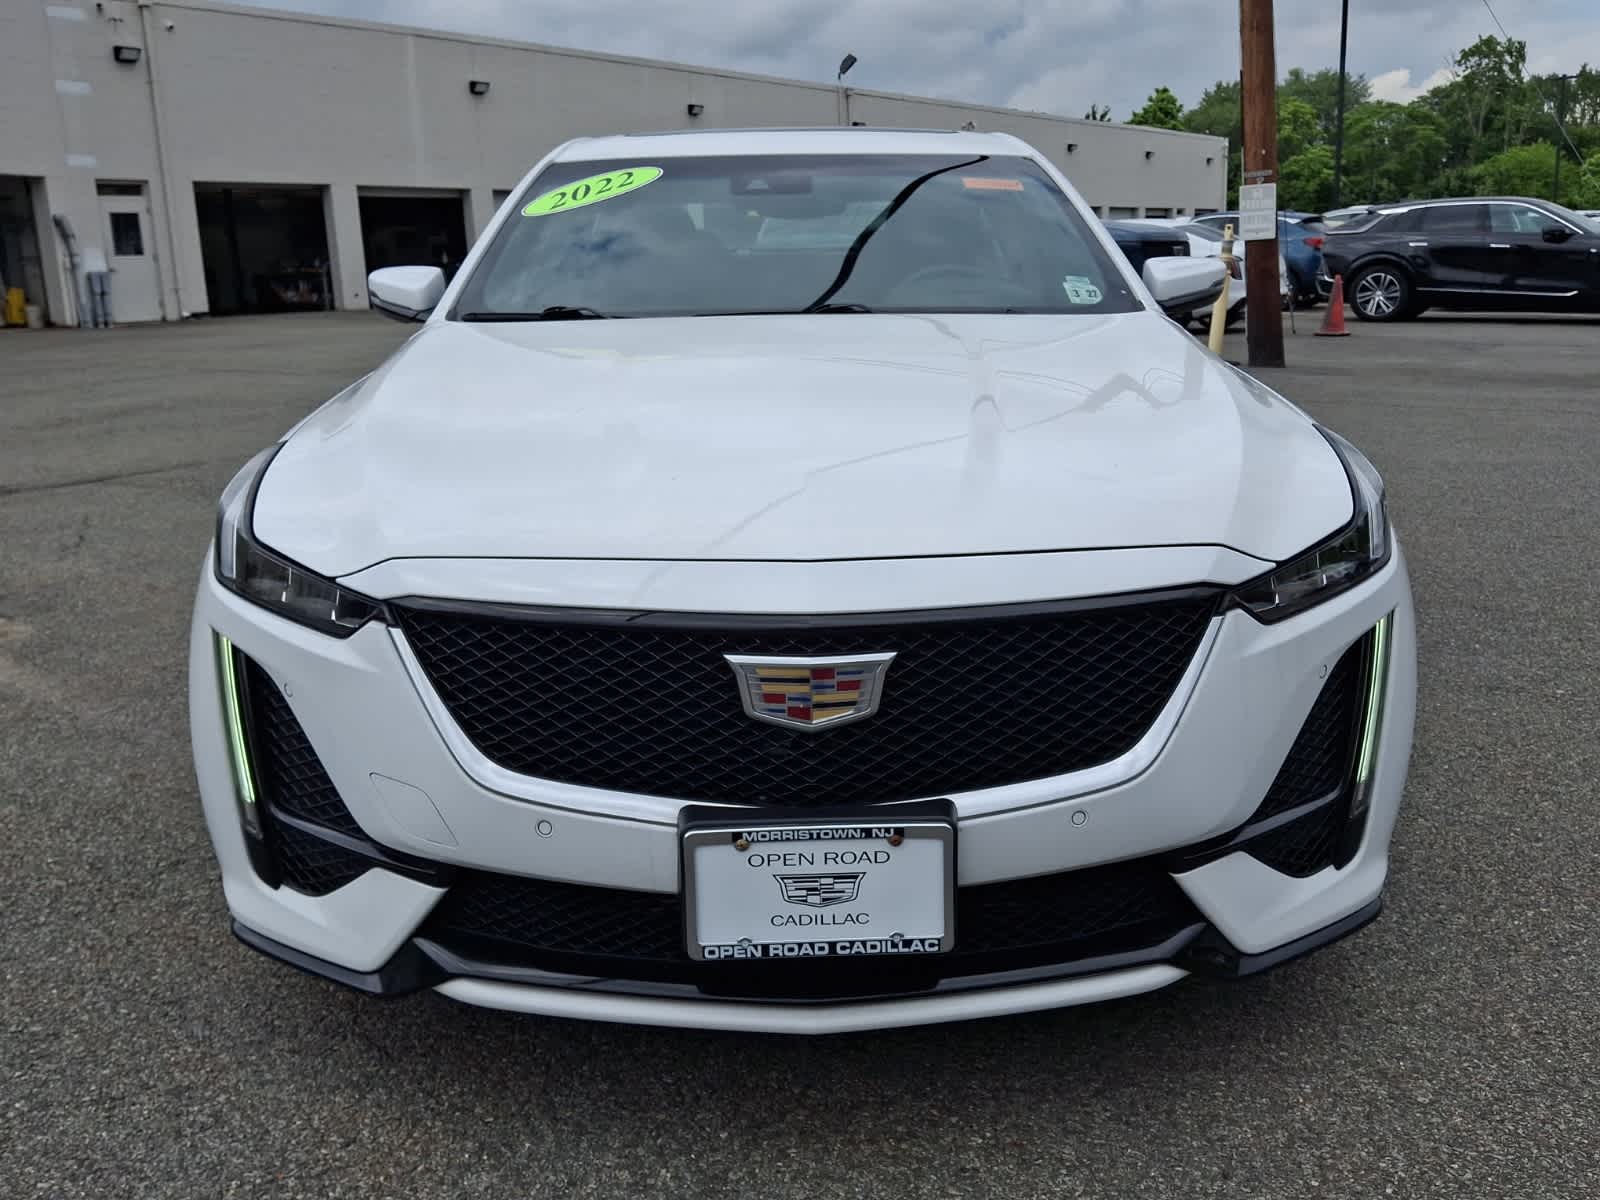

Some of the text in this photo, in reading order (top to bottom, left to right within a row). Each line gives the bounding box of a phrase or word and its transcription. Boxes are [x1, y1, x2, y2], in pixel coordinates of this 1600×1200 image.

[550, 171, 635, 210] 2022
[742, 828, 895, 843] MORRISTOWN, NJ
[747, 850, 890, 868] OPEN ROAD
[770, 912, 870, 927] CADILLAC
[704, 939, 939, 959] OPEN ROAD CADILLAC
